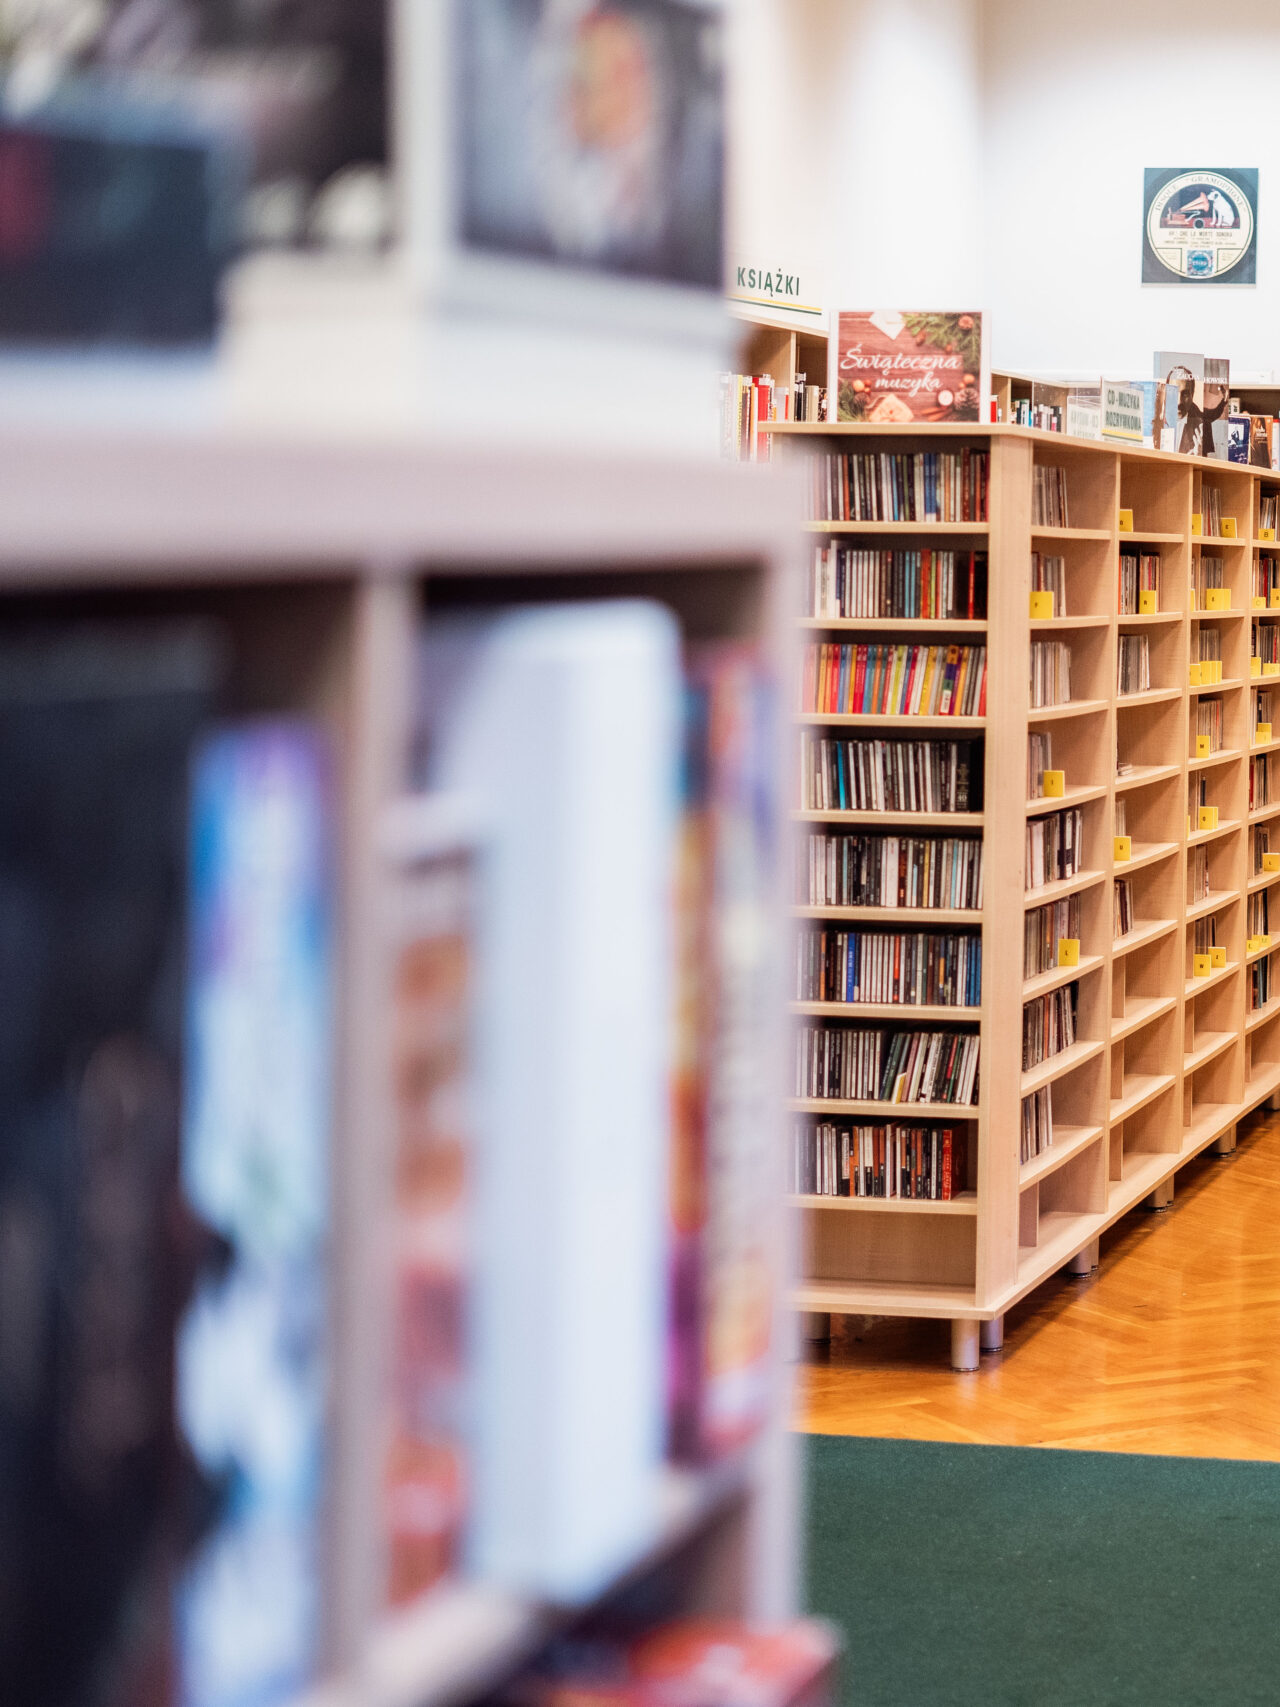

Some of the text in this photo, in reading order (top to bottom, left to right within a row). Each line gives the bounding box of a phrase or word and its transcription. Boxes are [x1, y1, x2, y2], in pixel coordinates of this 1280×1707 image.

[736, 266, 800, 297] KSIĄŻKI
[840, 343, 961, 376] Świąteczna
[874, 371, 943, 398] muzyka
